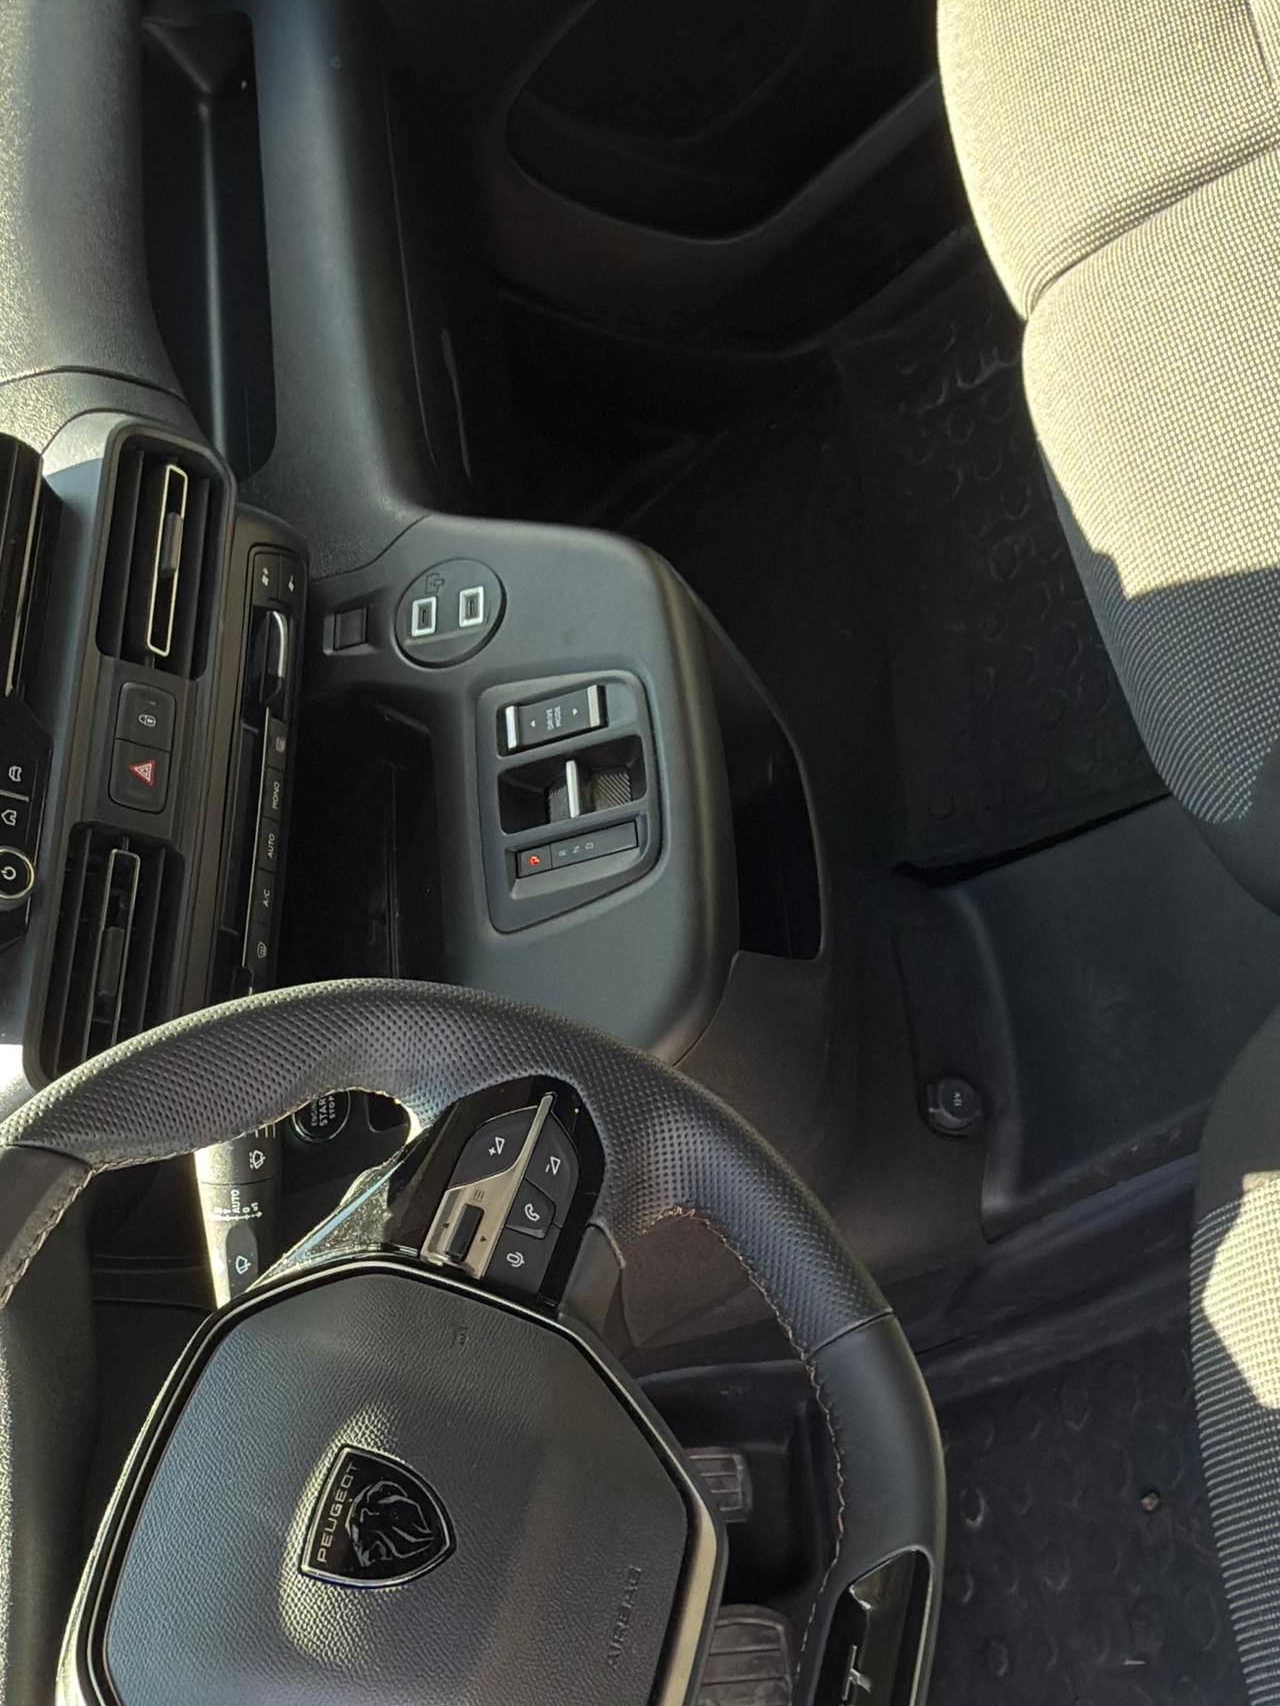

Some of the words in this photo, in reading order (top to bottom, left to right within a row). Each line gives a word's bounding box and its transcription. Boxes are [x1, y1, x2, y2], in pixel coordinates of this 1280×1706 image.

[545, 708, 555, 730] DRIVE
[554, 705, 562, 728] MODE
[271, 781, 281, 810] MONO
[266, 833, 277, 859] AUTO
[262, 888, 272, 908] A/C
[318, 1097, 328, 1126] STAR
[230, 1189, 241, 1214] AUTO
[317, 1462, 357, 1563] PEUGEOT
[607, 1564, 642, 1670] AIRBAG
